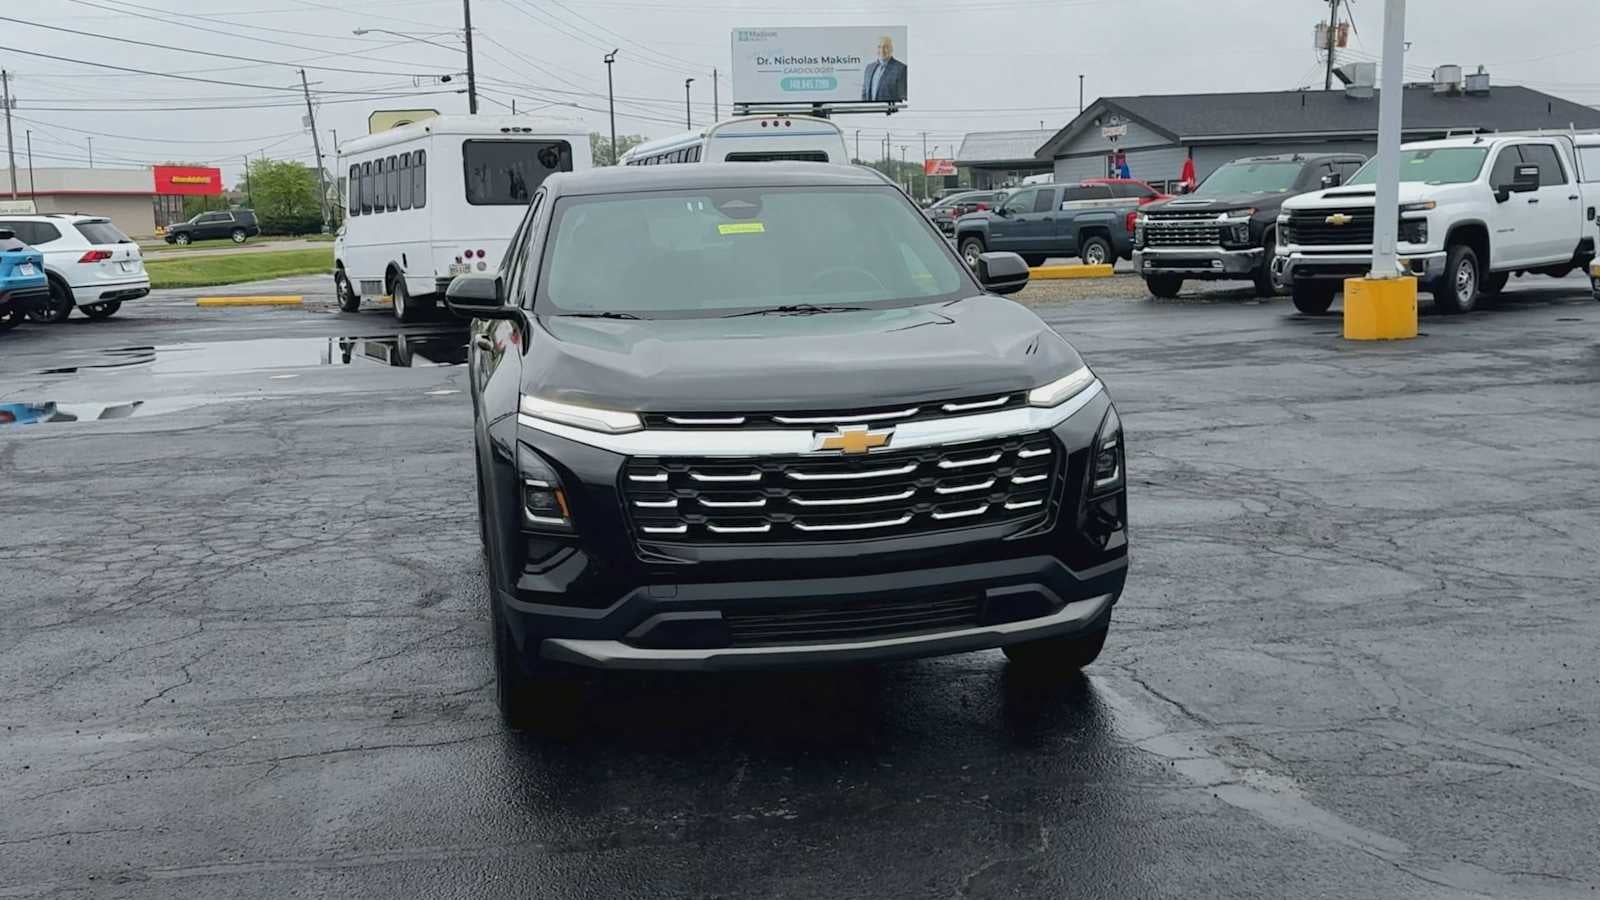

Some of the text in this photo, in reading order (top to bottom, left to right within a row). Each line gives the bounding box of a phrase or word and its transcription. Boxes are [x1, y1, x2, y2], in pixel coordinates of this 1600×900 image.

[756, 55, 861, 65] Dr. Nicholas Maksim
